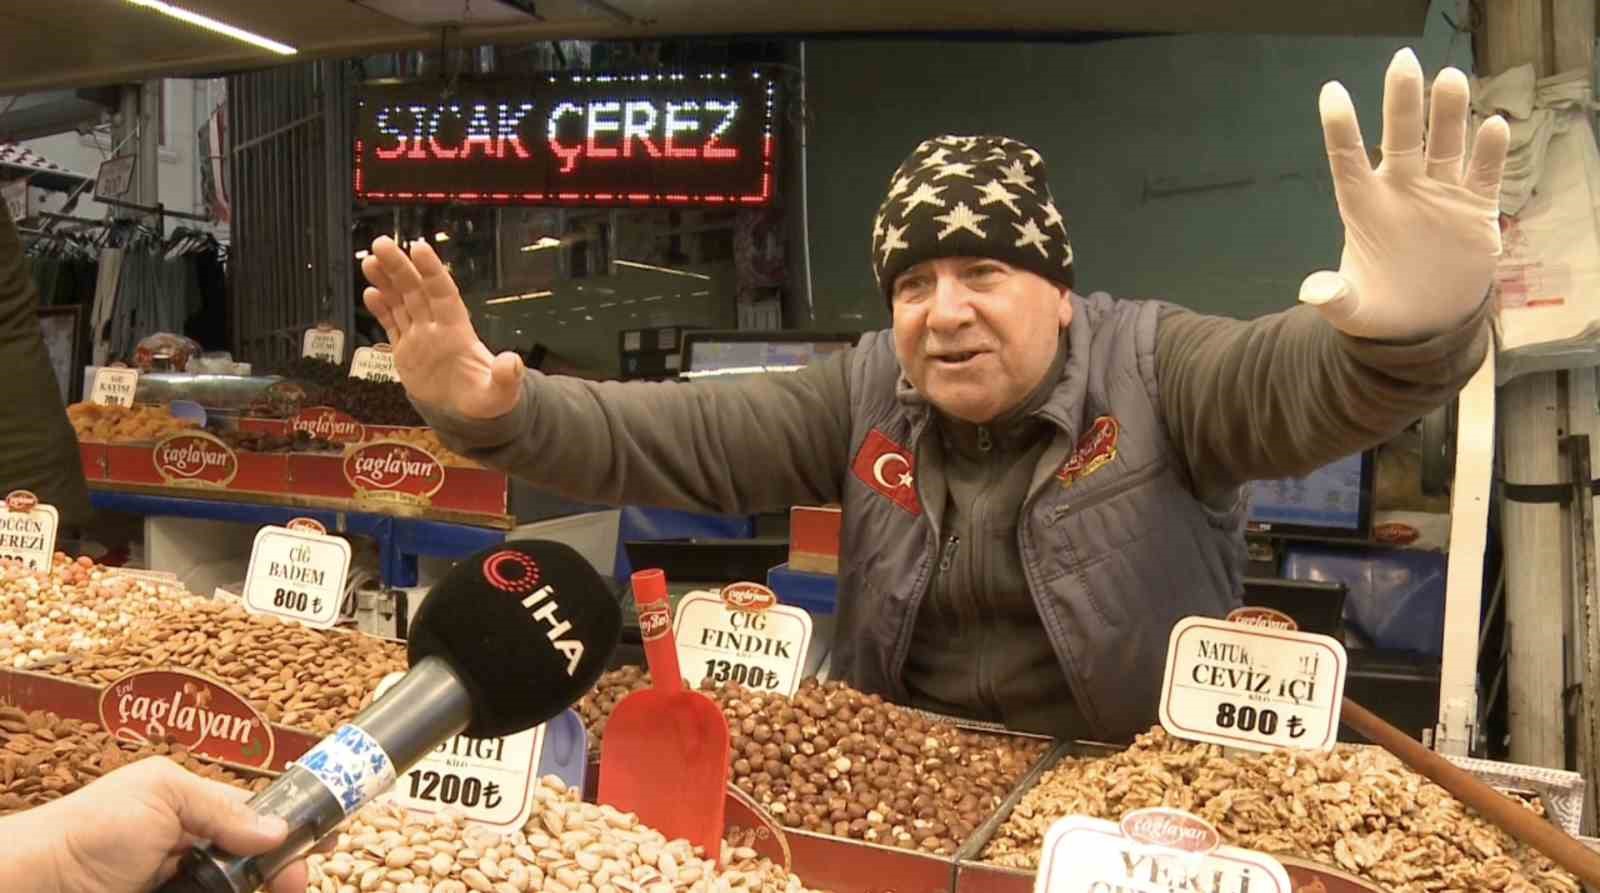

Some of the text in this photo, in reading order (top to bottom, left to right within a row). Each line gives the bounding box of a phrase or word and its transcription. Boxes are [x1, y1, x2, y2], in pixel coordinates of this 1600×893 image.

[377, 100, 738, 173] SICAK ÇEREZ
[269, 561, 325, 586] BADEM
[273, 587, 308, 612] 800
[521, 585, 585, 676] İHA
[700, 628, 792, 658] FINDIK
[1191, 663, 1272, 696] CEVİZ
[1215, 702, 1279, 736] 800
[408, 769, 503, 810] 1200₺
